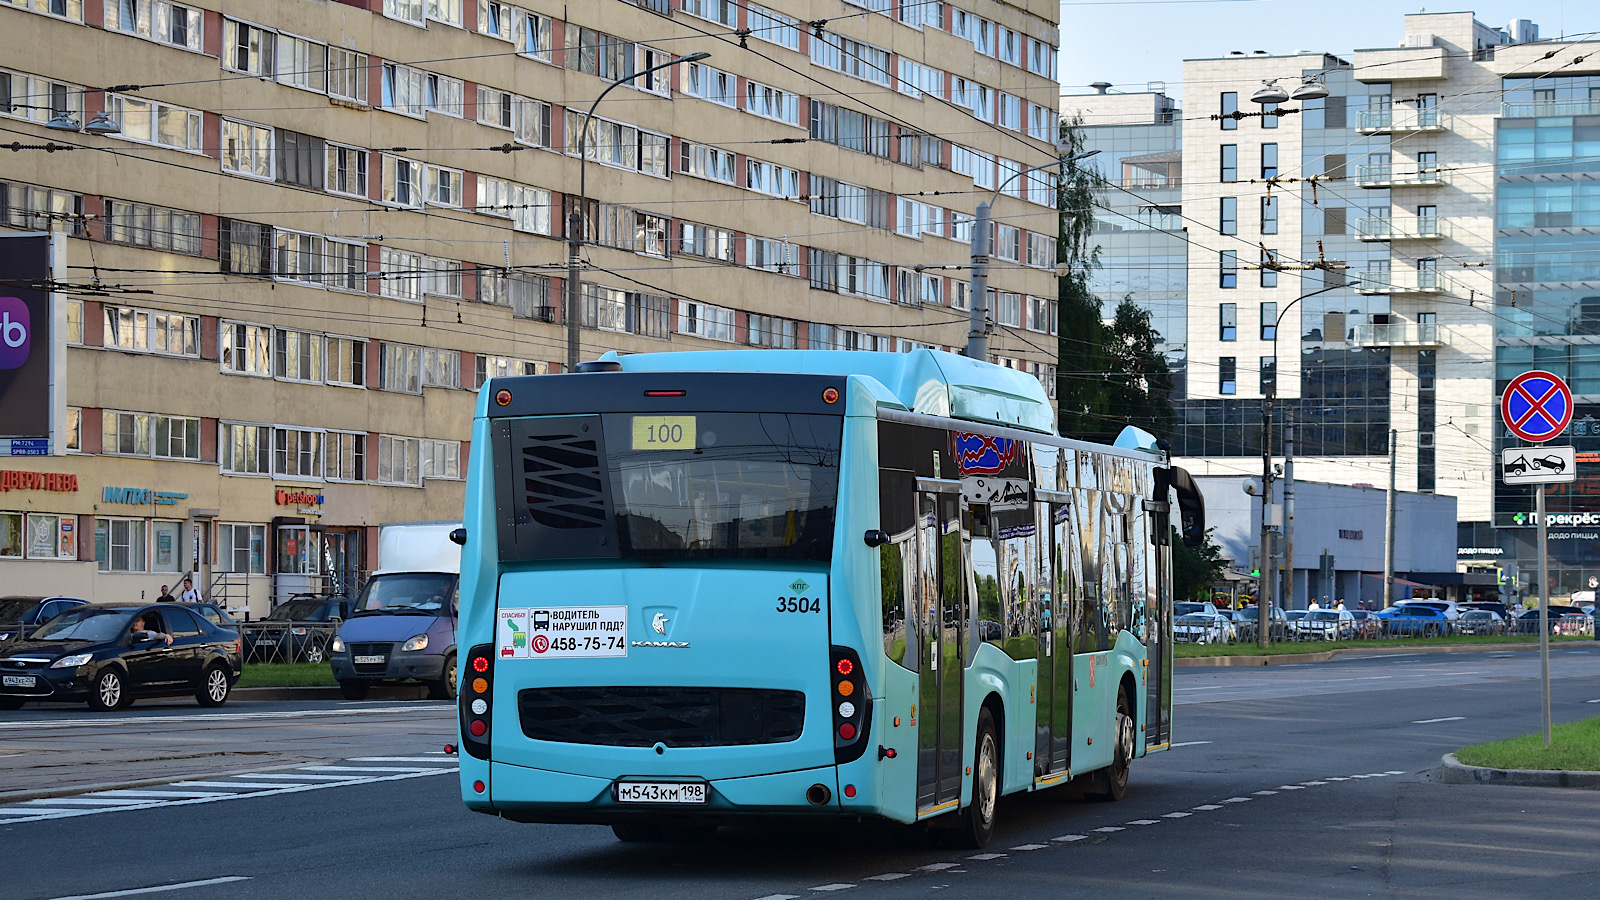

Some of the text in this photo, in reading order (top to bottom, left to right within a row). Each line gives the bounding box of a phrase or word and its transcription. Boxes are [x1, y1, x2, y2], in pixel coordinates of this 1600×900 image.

[0, 311, 27, 348] b
[647, 424, 683, 443] 100
[0, 470, 79, 492] ДВЕРИ НЕВА
[103, 487, 150, 505] INVITRO
[1529, 512, 1600, 527] Прекрёс
[1457, 547, 1504, 555] ДОДО ПИЦЦА
[792, 582, 806, 590] КПГ
[776, 596, 821, 614] 3504
[552, 610, 600, 620] ВОДИТЕЛЬ
[552, 621, 624, 631] НАРУШИЛ ПДД?
[550, 637, 625, 651] 458-75-74
[631, 640, 691, 649] KAMAZ
[681, 785, 702, 797] 198
